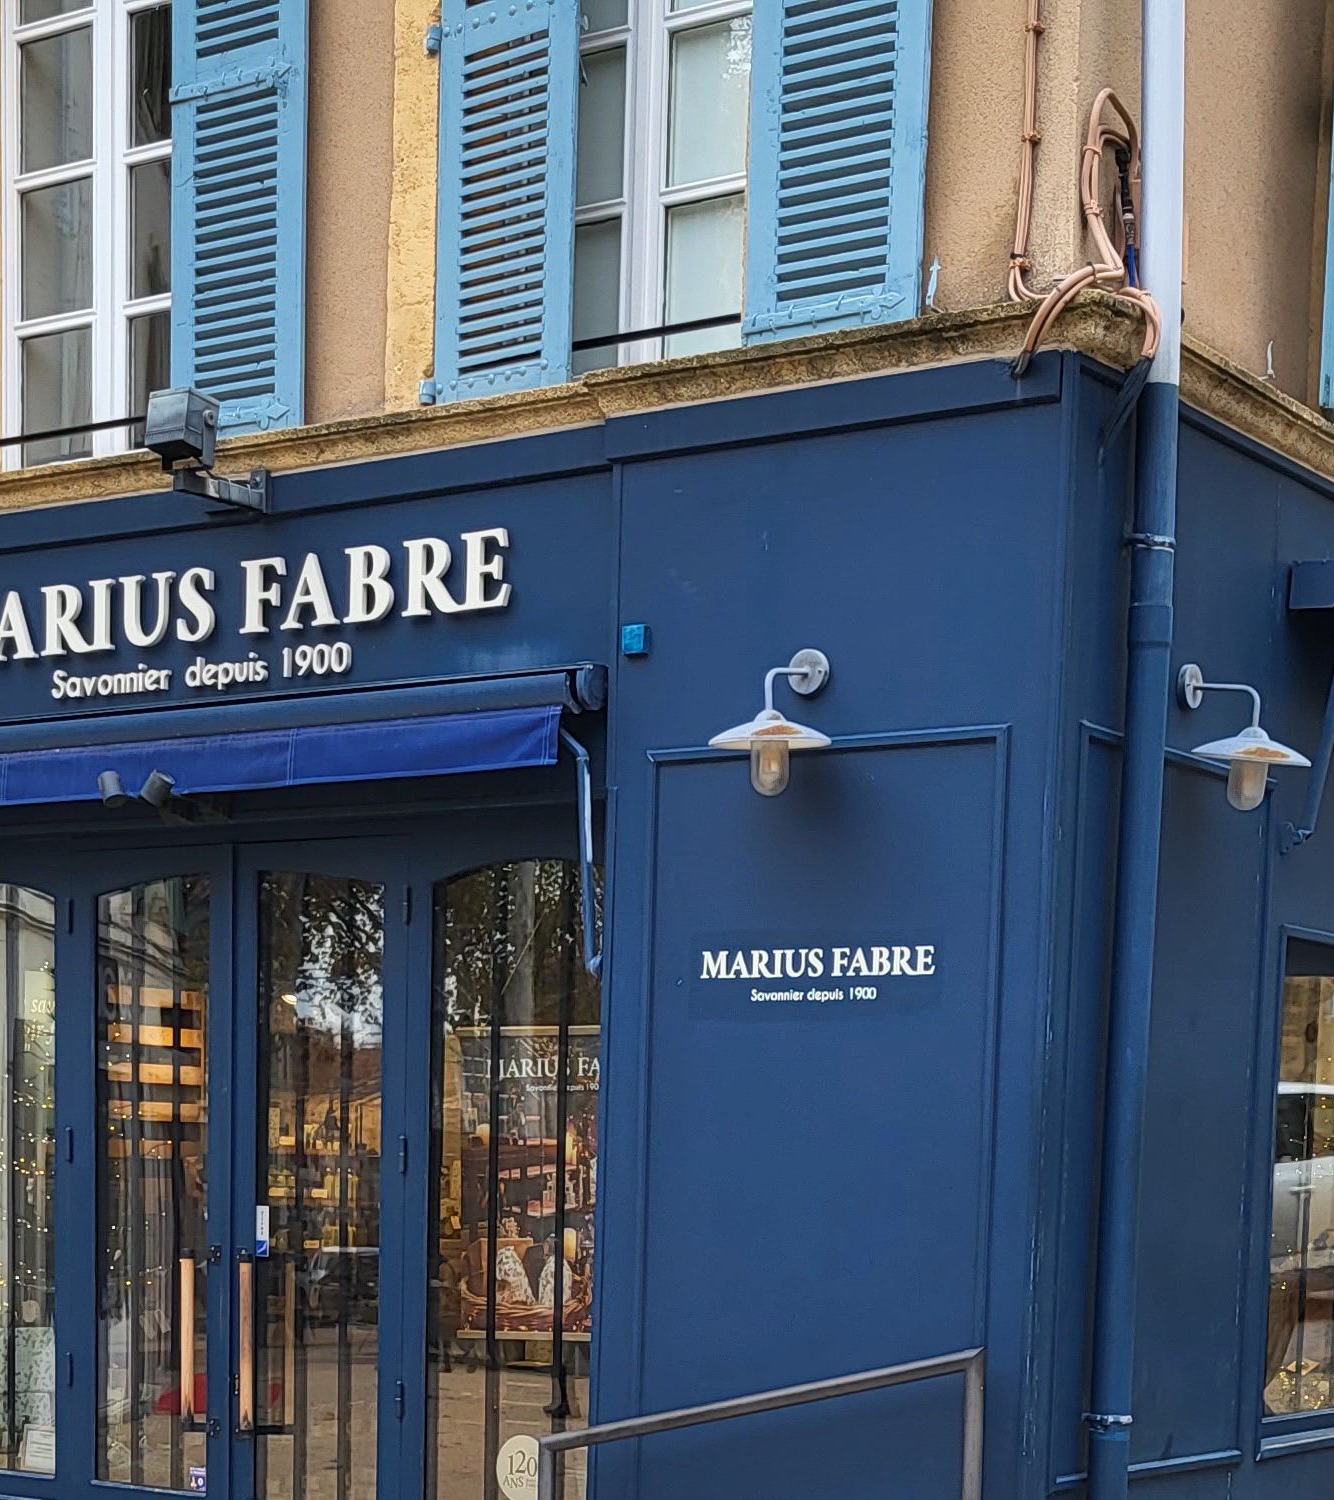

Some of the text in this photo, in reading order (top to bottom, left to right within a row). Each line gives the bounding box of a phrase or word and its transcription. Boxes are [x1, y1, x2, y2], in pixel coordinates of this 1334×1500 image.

[239, 527, 512, 634] FABRE
[51, 641, 352, 699] Savonnier depuis 1900
[700, 945, 936, 979] MARIUS FABRE
[750, 987, 877, 1003] Savonnier depuis 1900
[507, 1449, 538, 1478] 120
[502, 1475, 524, 1489] ANS
